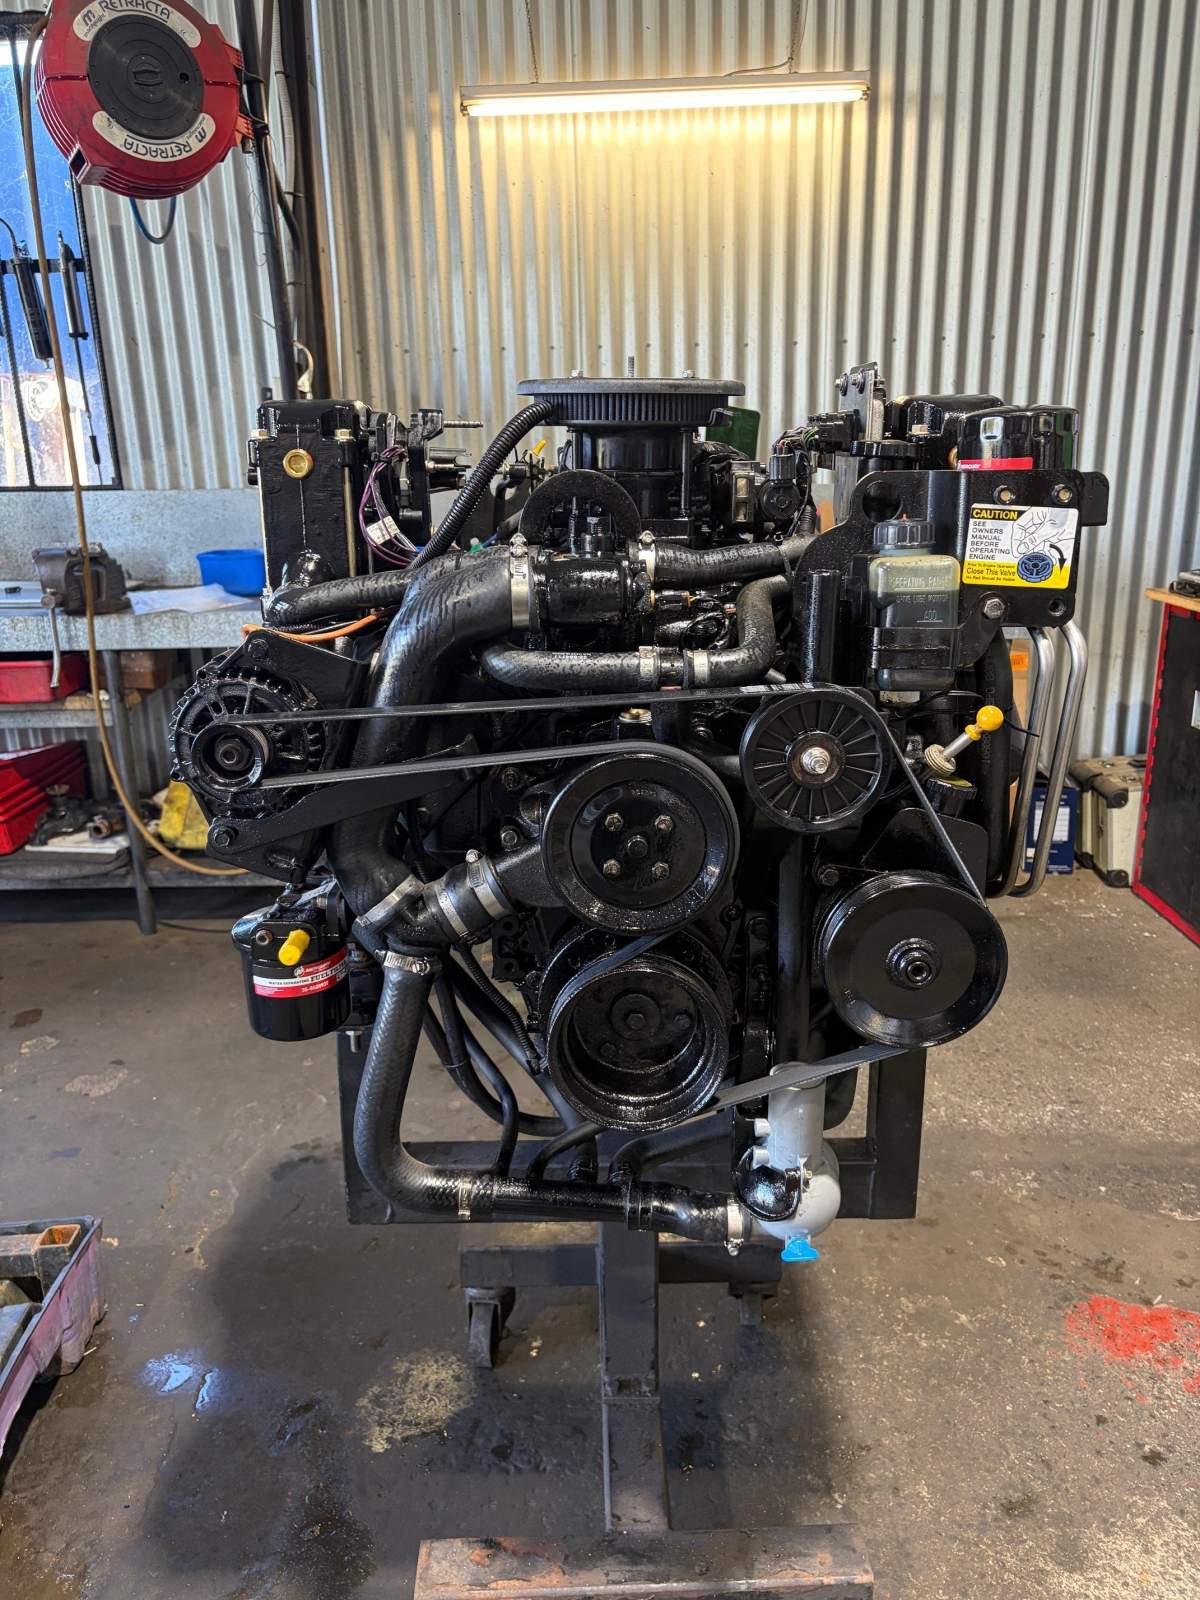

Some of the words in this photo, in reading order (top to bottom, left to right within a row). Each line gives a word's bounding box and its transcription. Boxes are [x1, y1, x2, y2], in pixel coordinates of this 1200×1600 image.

[98, 0, 171, 20] RETRACTA
[123, 138, 193, 159] RETRACTA
[972, 509, 1018, 520] CAUTION
[969, 547, 1010, 555] OPERATING
[1000, 569, 1016, 577] Valve
[311, 971, 330, 981] FUEL
